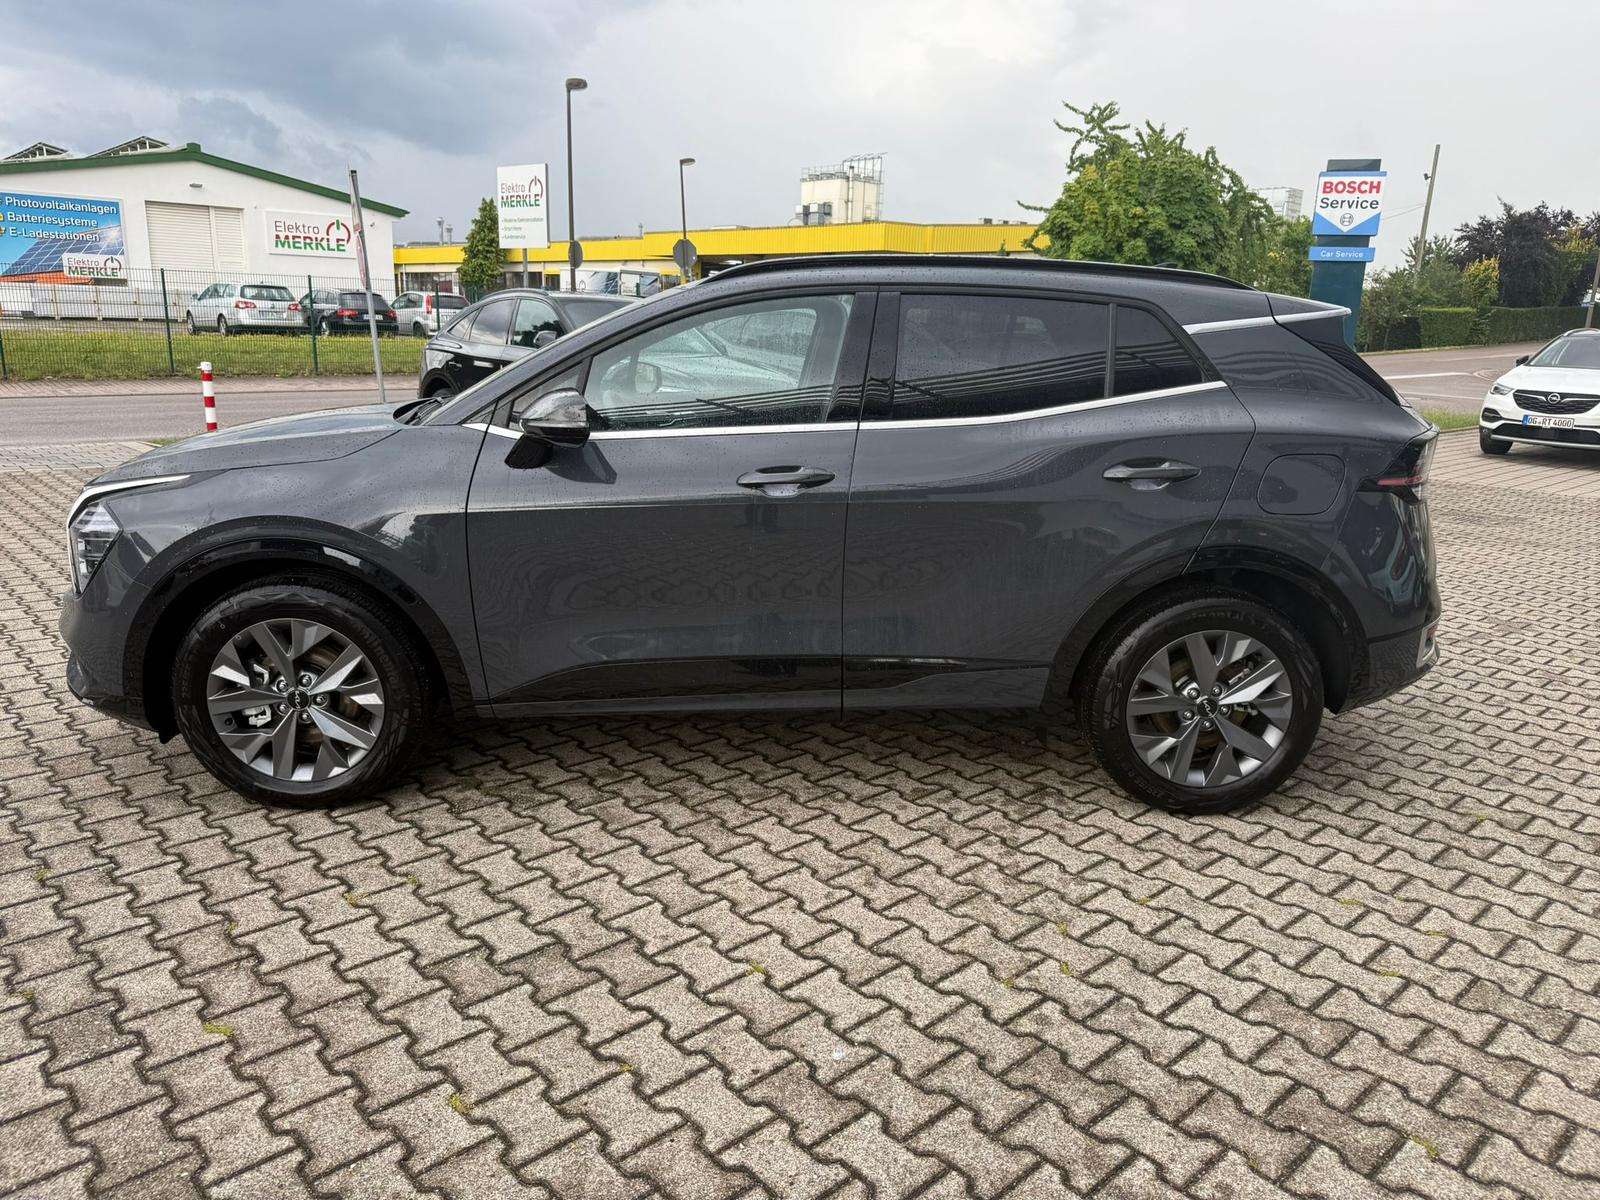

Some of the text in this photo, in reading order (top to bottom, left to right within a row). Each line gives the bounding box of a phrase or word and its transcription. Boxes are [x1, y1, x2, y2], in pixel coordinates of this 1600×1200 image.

[500, 182, 526, 194] Elektro
[1322, 180, 1382, 194] BOSCH
[5, 196, 117, 215] Photovoltaikanlagen
[500, 194, 540, 208] MERKLE
[1319, 196, 1380, 210] Service
[7, 211, 98, 227] Batteriesysteme
[9, 227, 101, 242] E-Ladestationen
[274, 220, 320, 235] Elektro
[274, 234, 347, 252] MERKLE
[1320, 250, 1364, 258] Car Service
[67, 257, 100, 267] Elektro
[67, 265, 119, 277] MERKLE
